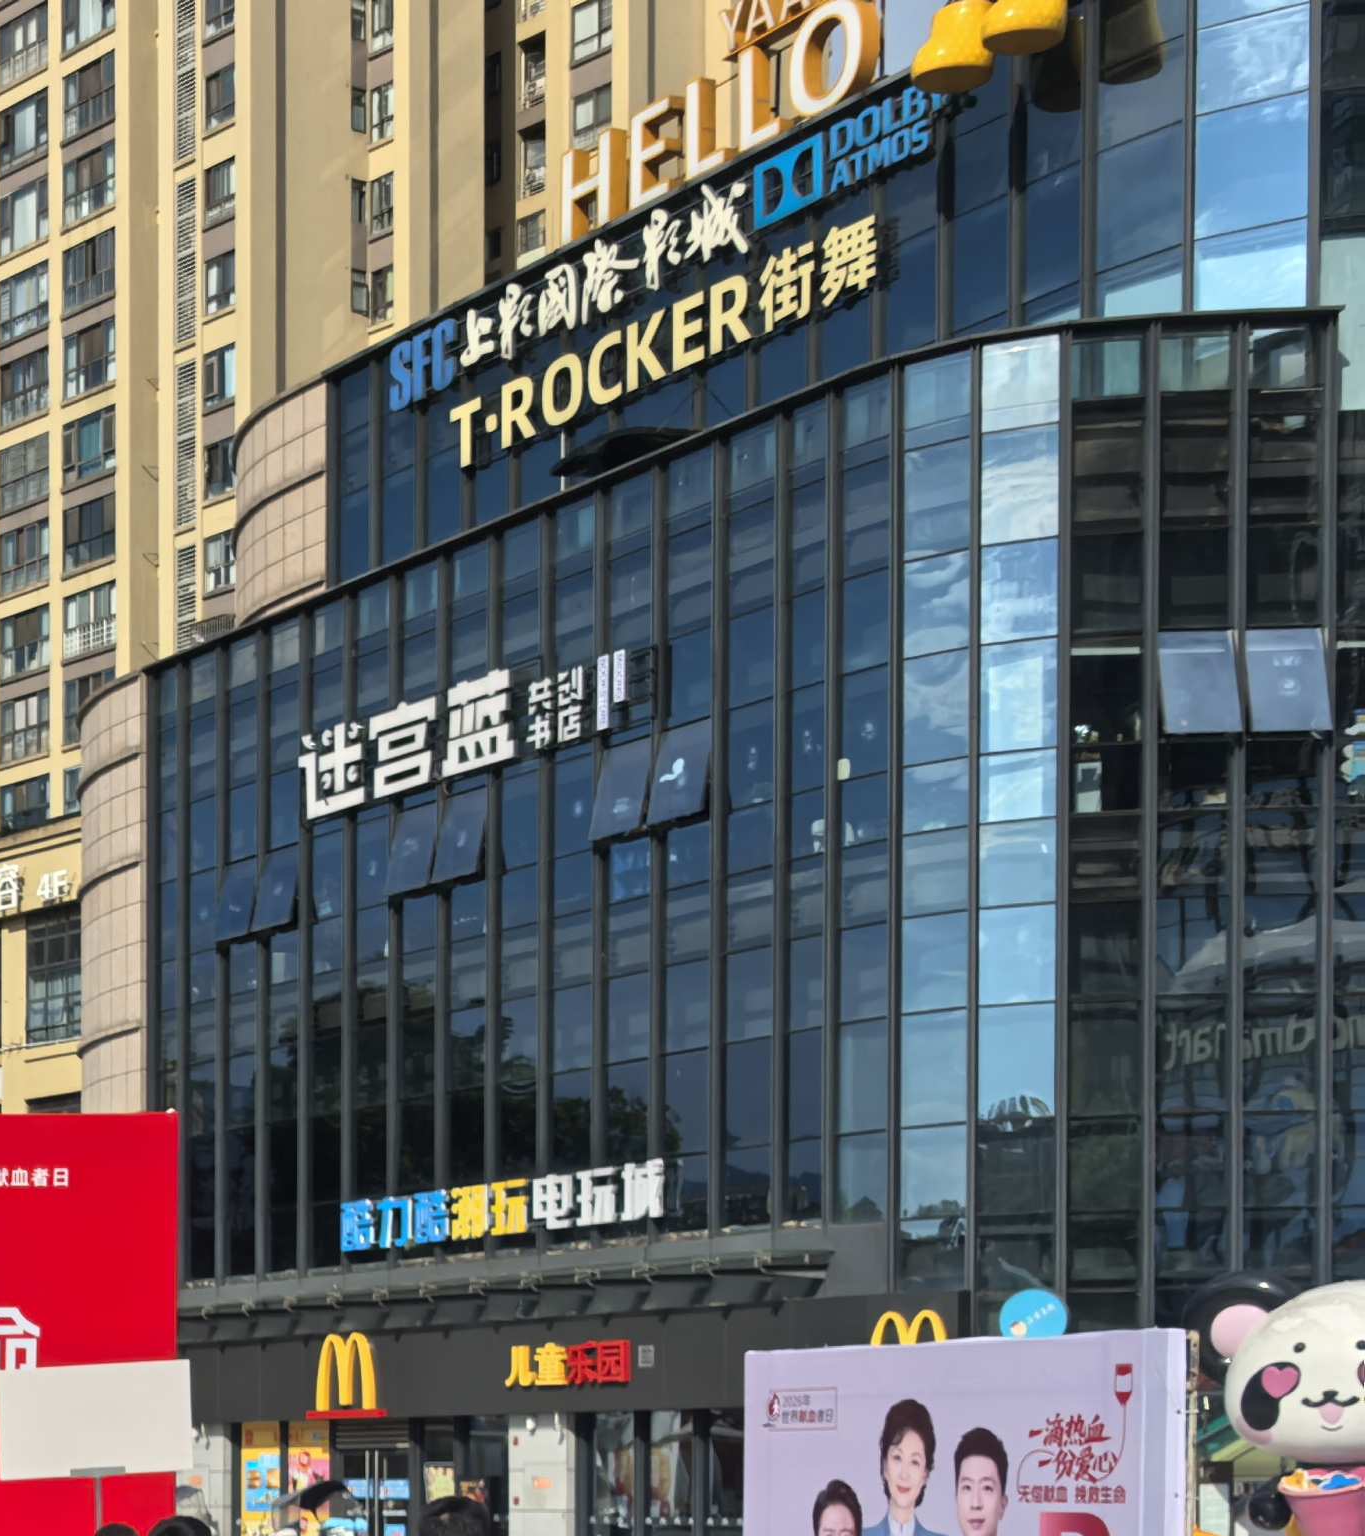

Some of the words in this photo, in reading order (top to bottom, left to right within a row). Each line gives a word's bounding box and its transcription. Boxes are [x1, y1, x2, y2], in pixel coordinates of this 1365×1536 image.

[561, 0, 879, 242] HELLO
[830, 119, 931, 194] ATMOS
[759, 214, 878, 333] 街舞
[389, 318, 459, 413] SFC
[298, 668, 516, 820] 迷宫蓝
[526, 704, 583, 749] 书店
[505, 1340, 631, 1387] 儿童乐园
[1028, 1412, 1112, 1448] 一滴热血
[1037, 1446, 1118, 1484] 一份爱心
